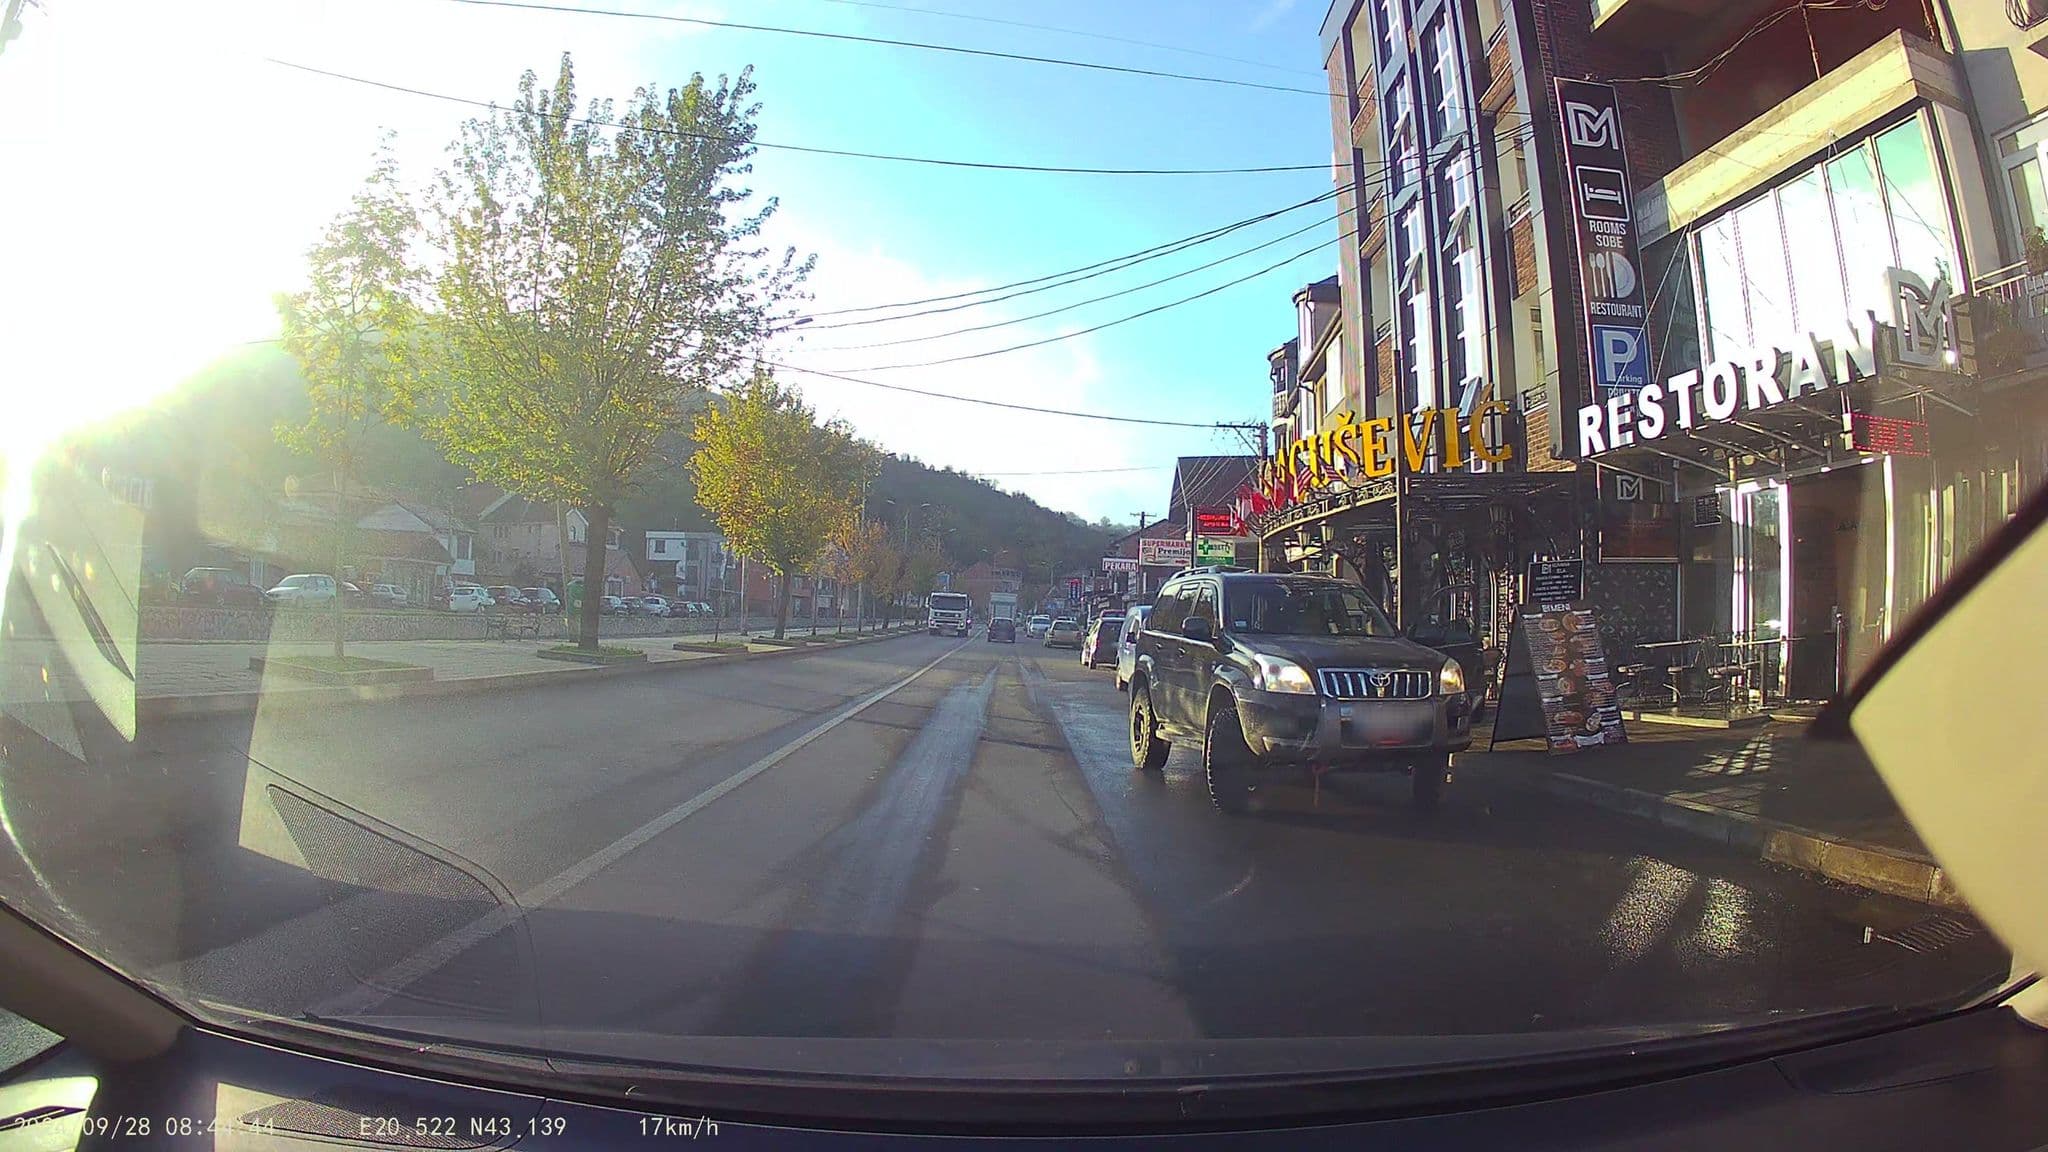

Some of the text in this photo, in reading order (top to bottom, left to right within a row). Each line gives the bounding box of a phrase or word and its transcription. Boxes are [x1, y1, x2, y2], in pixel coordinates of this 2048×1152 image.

[1589, 220, 1627, 235] ROOMS
[1595, 235, 1624, 249] SOBE
[1590, 301, 1643, 319] RESTOURANT
[1578, 310, 1876, 458] RESTORAN
[1104, 561, 1136, 571] PEKARA
